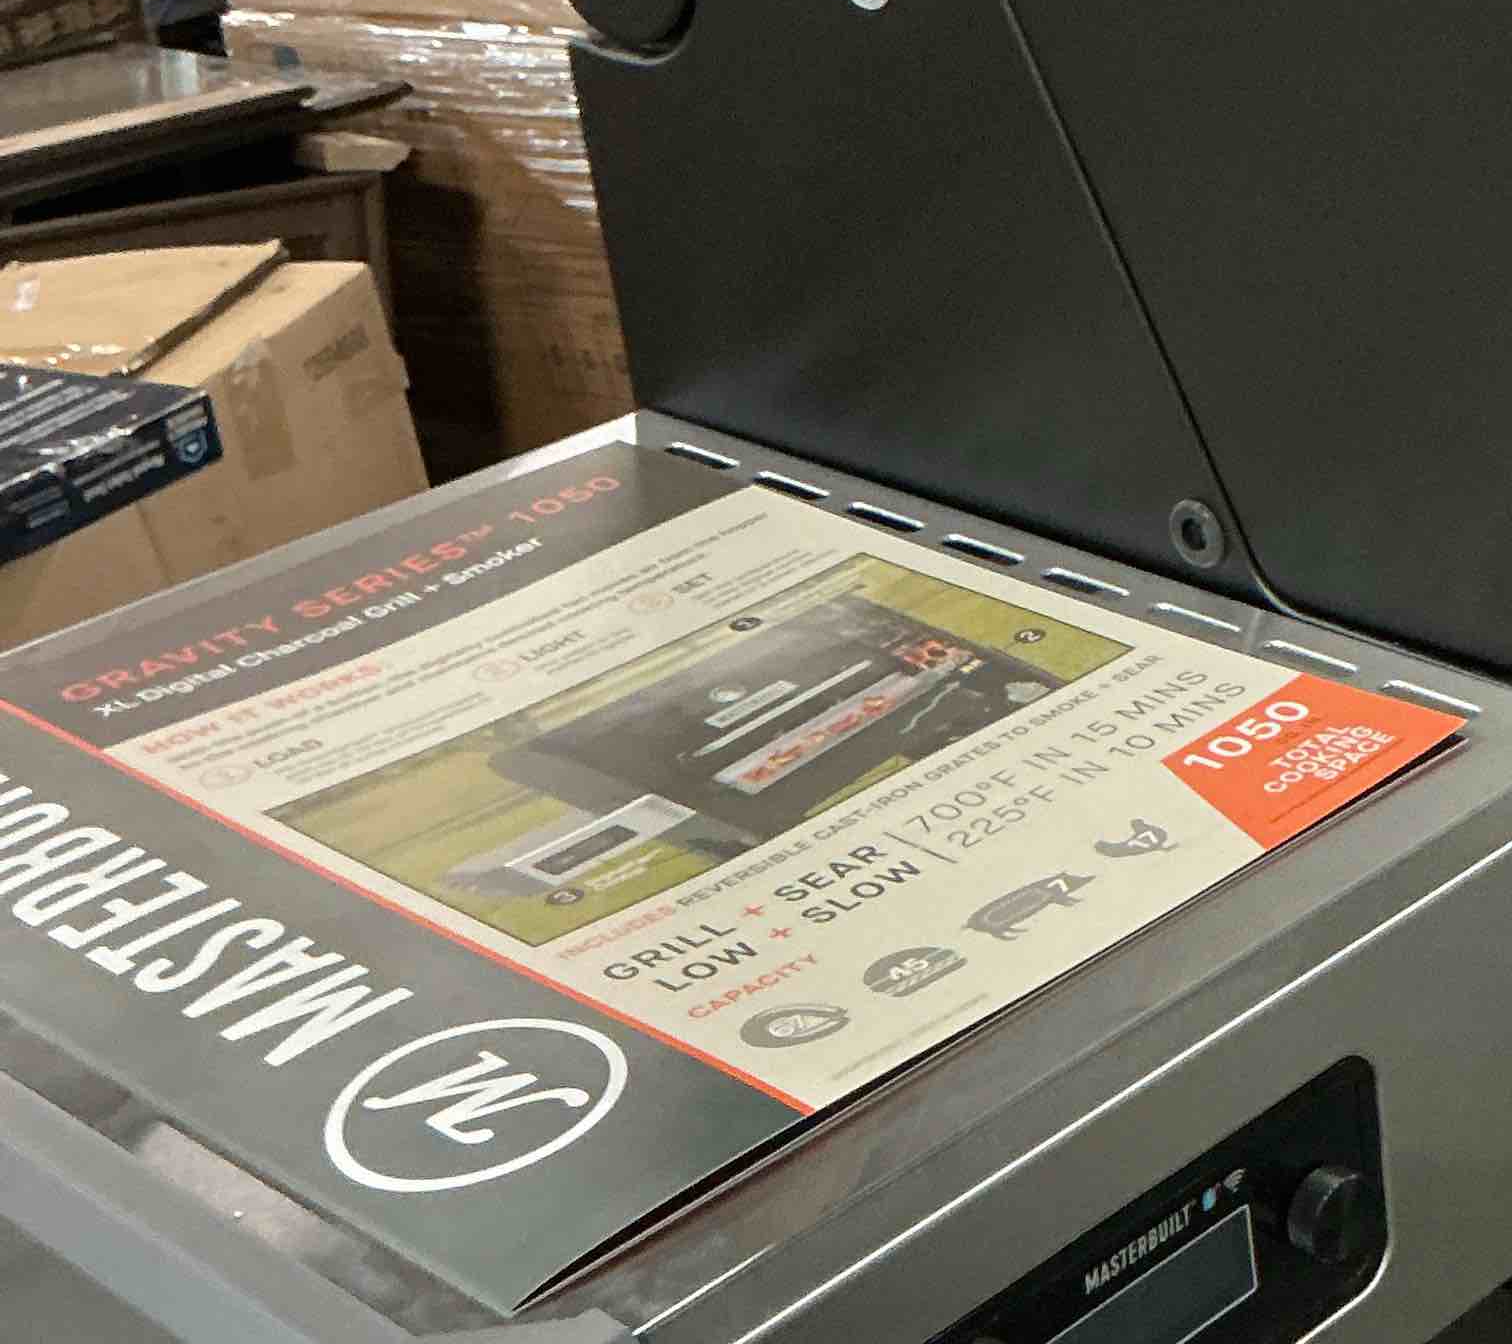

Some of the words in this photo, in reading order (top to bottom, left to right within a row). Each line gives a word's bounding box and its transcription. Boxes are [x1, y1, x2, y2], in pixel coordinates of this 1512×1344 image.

[61, 615, 281, 703] GRAVITY
[508, 475, 621, 524] 1050
[92, 699, 141, 719] XL
[135, 662, 237, 703] Digital
[235, 614, 366, 667] Charcoal
[363, 591, 423, 620] Grill
[442, 536, 543, 586] Smoker
[1183, 700, 1310, 769] 1050
[1262, 725, 1374, 794] COOKING
[1268, 726, 1352, 769] TOTAL
[1312, 730, 1396, 781] SPACE
[676, 839, 813, 907] REVERSIBLE
[813, 779, 924, 842] CAST-IRON
[923, 739, 1002, 782] GRATES
[1000, 724, 1031, 743] TO
[1029, 689, 1100, 727] SMOKE
[1112, 655, 1167, 683] SEAR
[603, 922, 737, 981] GRILL
[774, 844, 889, 902] SEAR
[1022, 745, 1072, 772] IN
[1070, 719, 1119, 744] 15
[1114, 670, 1209, 721] MINS
[652, 940, 759, 993] LOW
[801, 859, 921, 924] SLOW
[1059, 760, 1111, 785] IN
[1108, 734, 1156, 758] 10
[1153, 682, 1247, 735] MINS
[1126, 830, 1160, 849] 17
[0, 772, 415, 1067] MASTERBU
[1046, 877, 1070, 895] 7
[687, 951, 819, 1019] CAPACITY
[1084, 1202, 1191, 1295] MASTERBUILT
